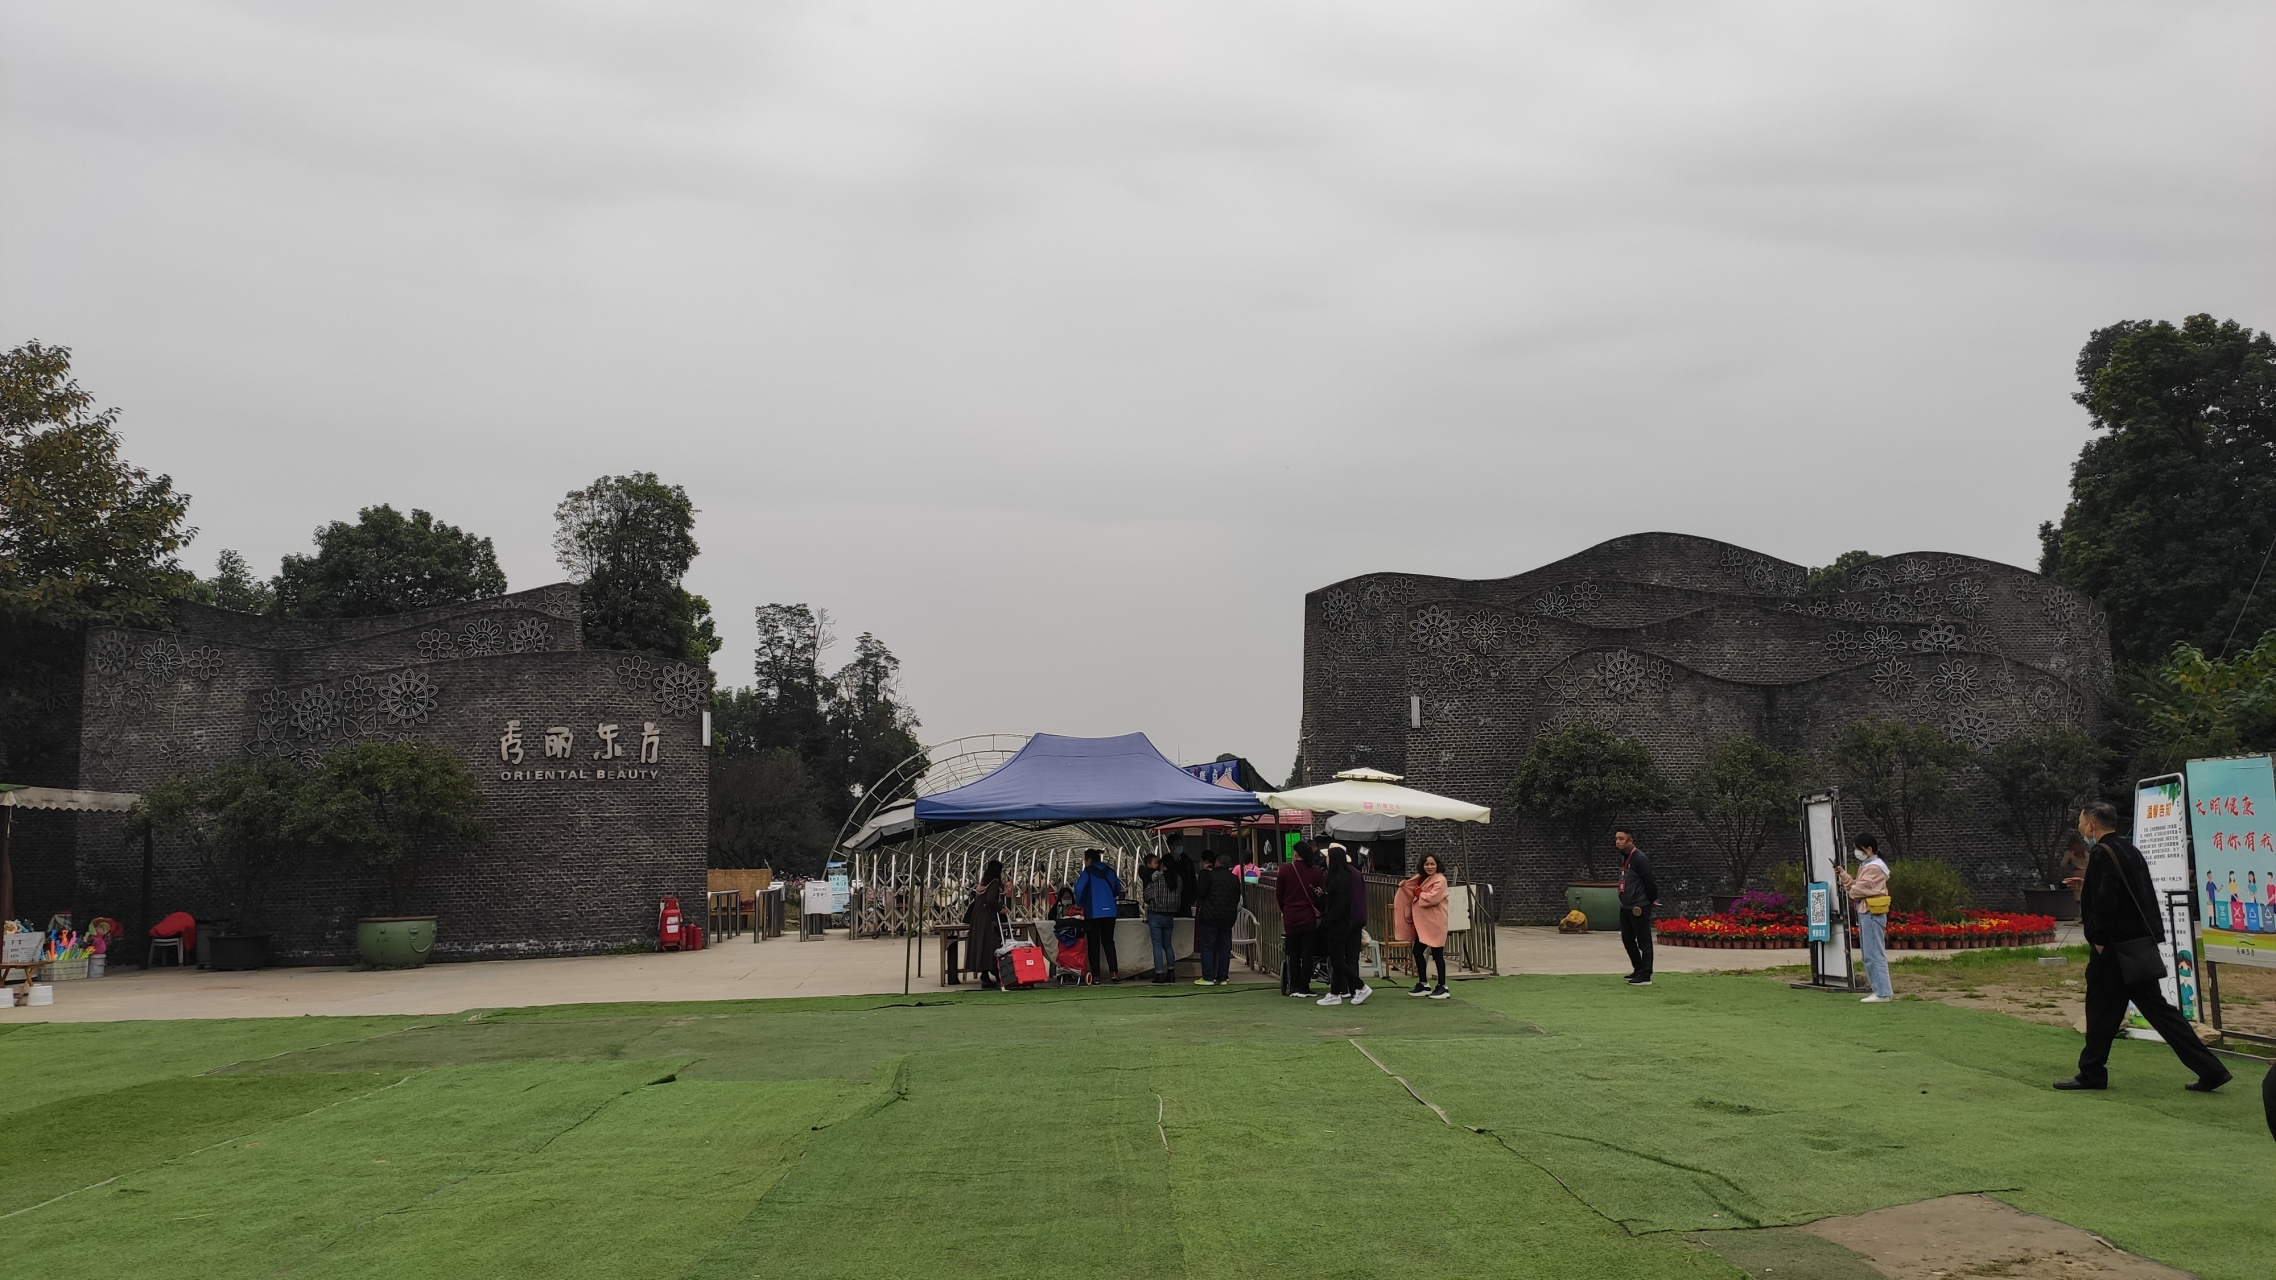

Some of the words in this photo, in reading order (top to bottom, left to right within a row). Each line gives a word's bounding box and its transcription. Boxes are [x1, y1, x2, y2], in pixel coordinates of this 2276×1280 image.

[500, 720, 660, 765] 秀丽东方
[500, 769, 588, 781] ORIENTAL
[596, 769, 659, 780] BEAUTY
[2146, 802, 2172, 820] 温馨告知
[2195, 795, 2255, 817] 文明健康
[2212, 830, 2274, 853] 有你有我
